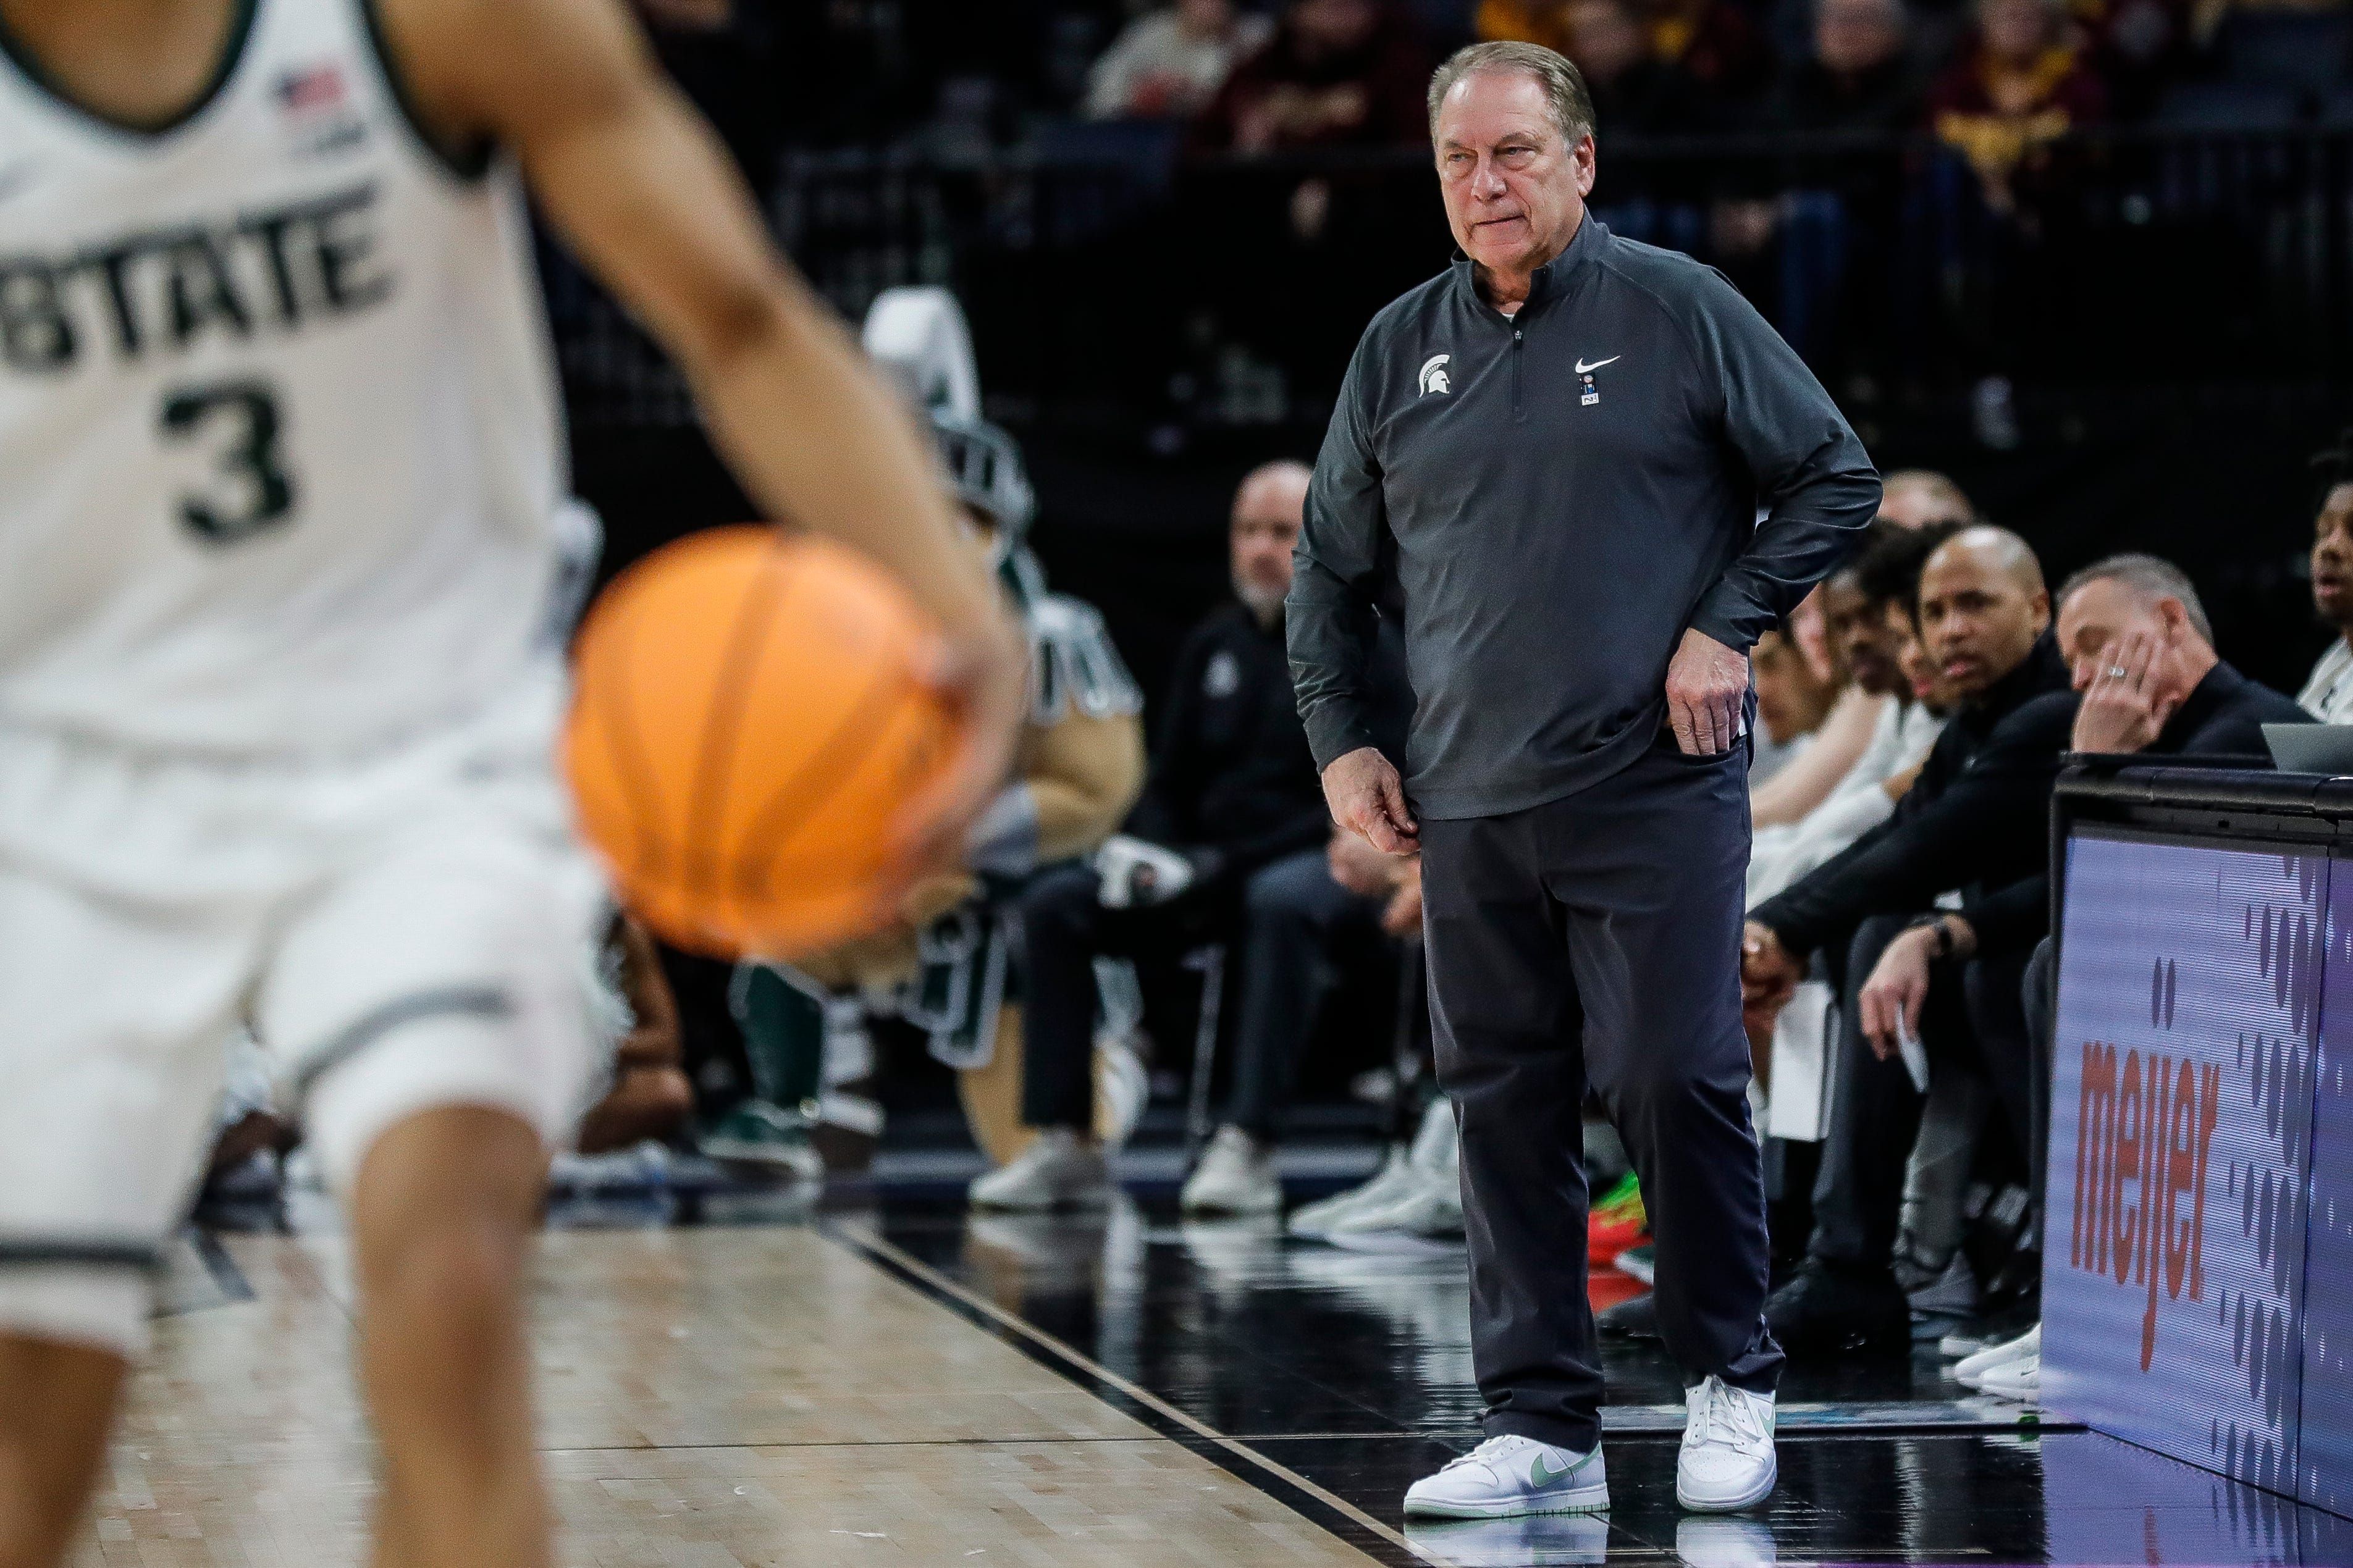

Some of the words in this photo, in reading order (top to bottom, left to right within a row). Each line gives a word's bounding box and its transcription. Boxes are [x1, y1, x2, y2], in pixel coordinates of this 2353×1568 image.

[0, 178, 395, 372] STATE
[158, 377, 298, 545] 3
[2071, 957, 2220, 1372] meijer
